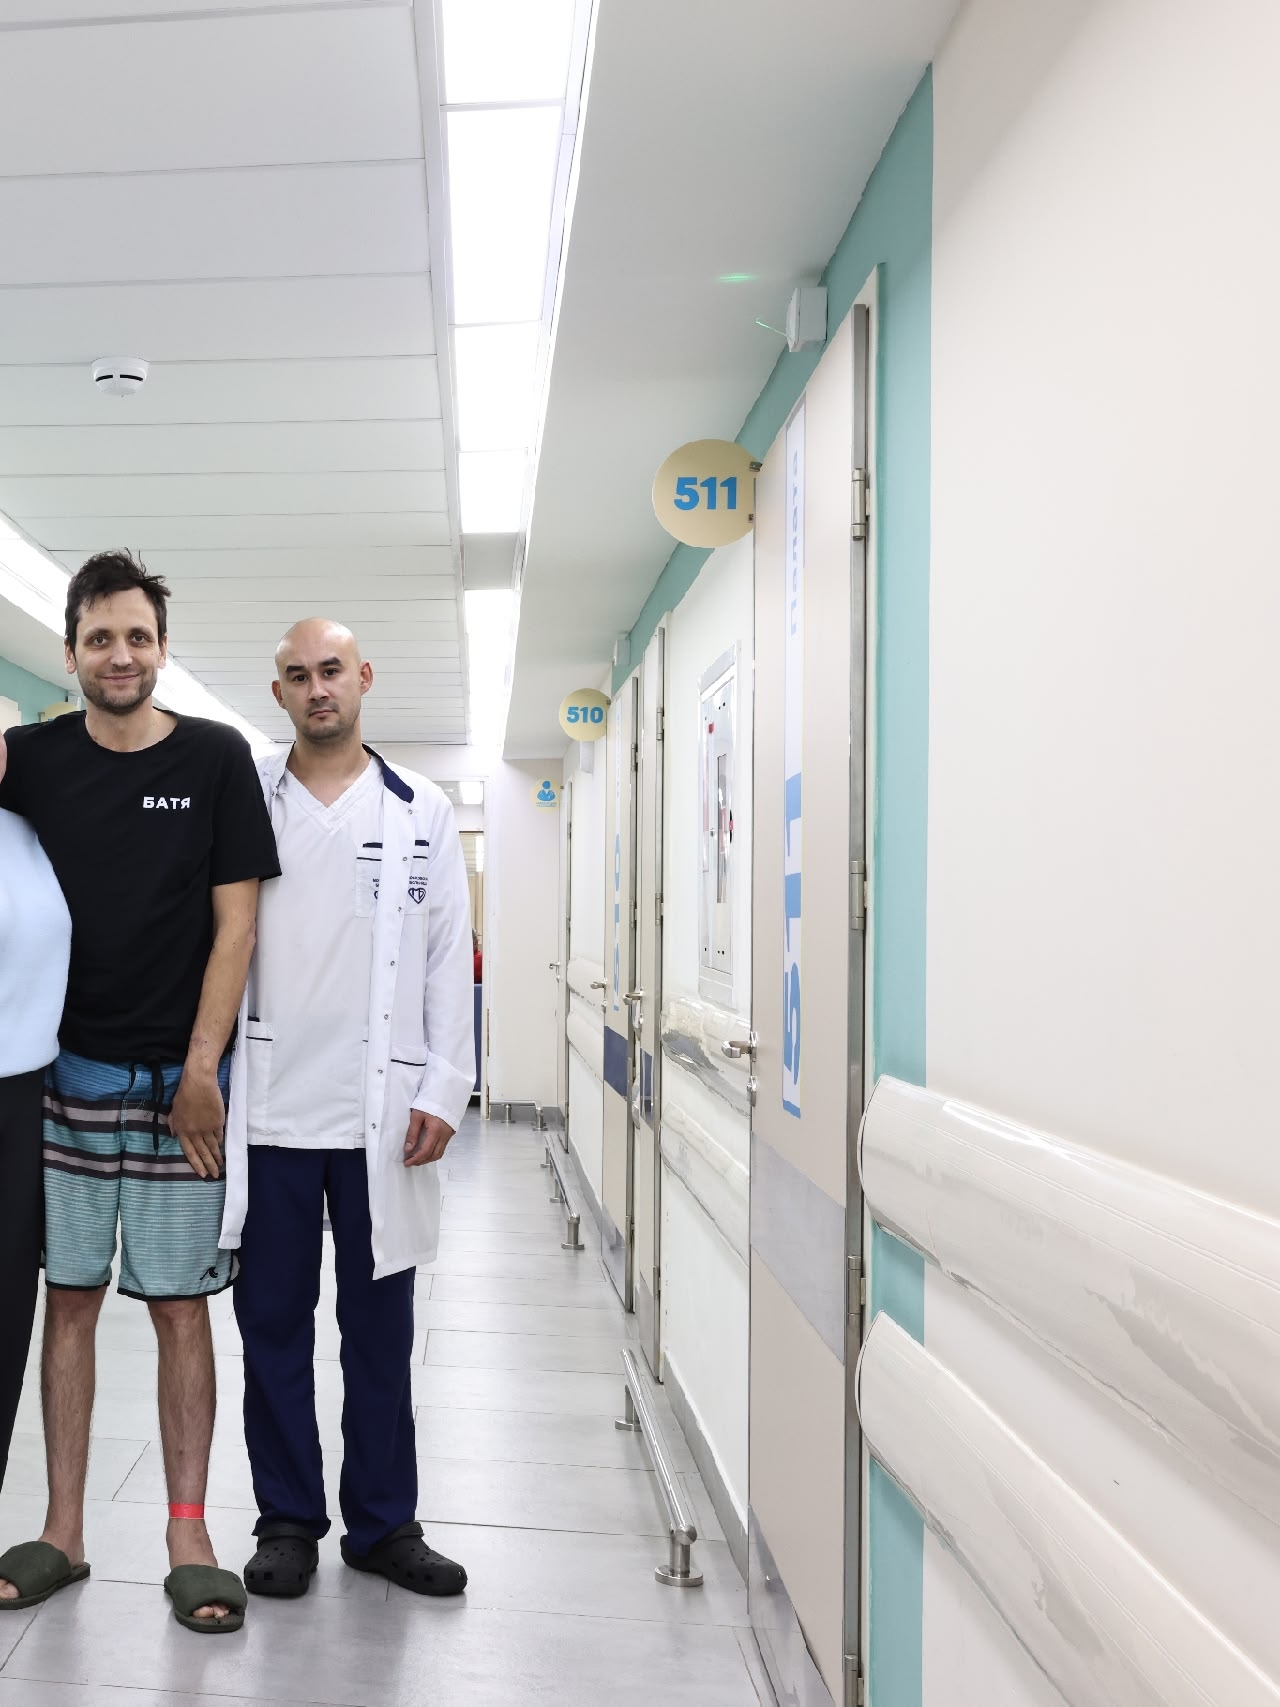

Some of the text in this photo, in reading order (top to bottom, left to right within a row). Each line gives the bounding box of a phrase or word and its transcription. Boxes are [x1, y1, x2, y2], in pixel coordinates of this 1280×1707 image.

[674, 477, 737, 510] 511
[567, 707, 603, 723] 510
[143, 796, 191, 809] БАТЯ
[784, 772, 802, 1085] 511
